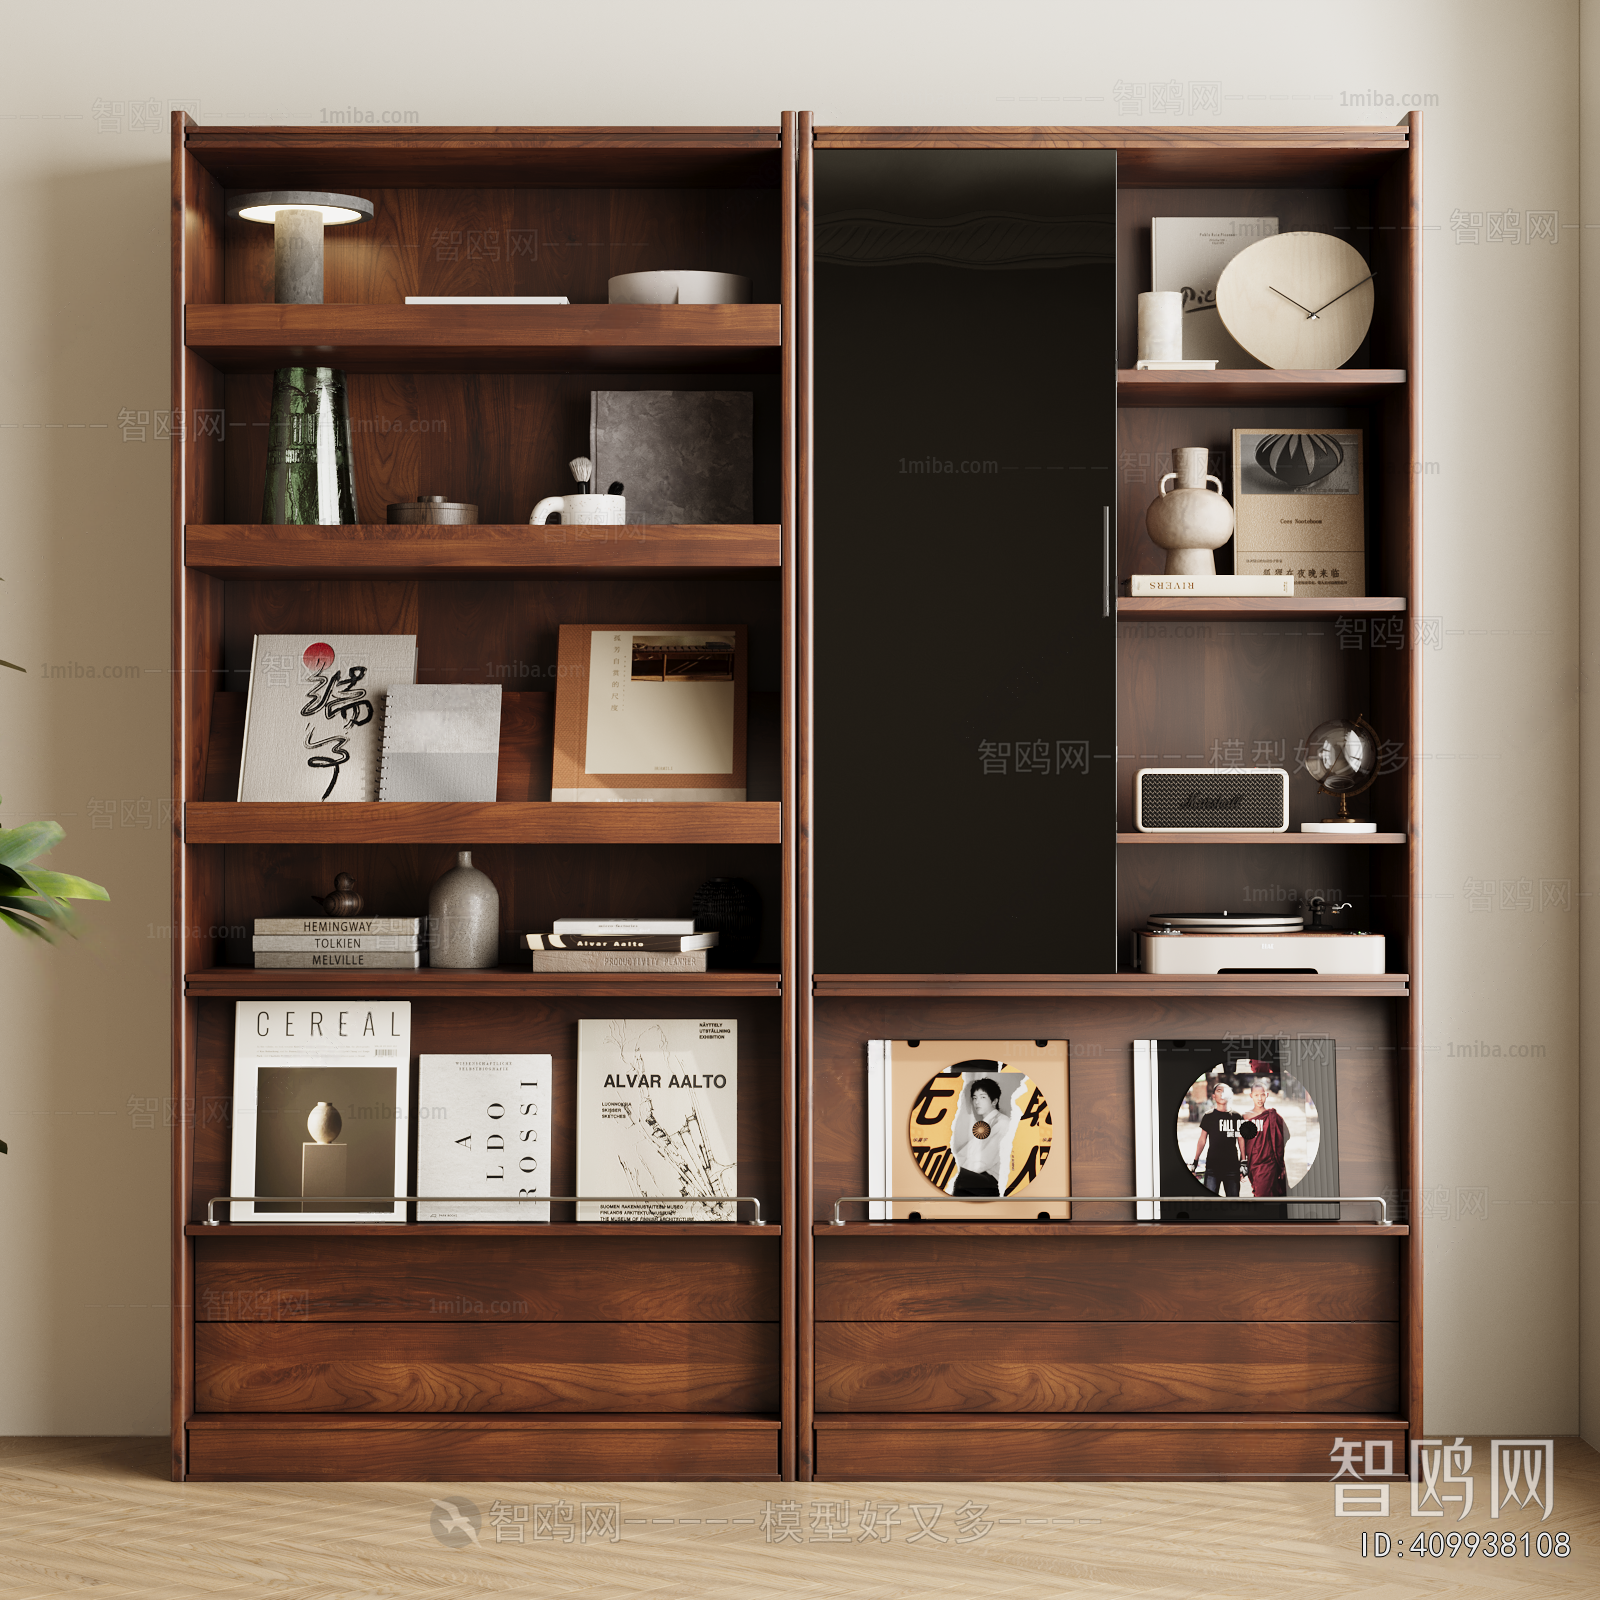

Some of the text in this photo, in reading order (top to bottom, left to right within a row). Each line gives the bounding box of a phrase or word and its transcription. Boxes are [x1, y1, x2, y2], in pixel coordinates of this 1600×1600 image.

[1149, 581, 1195, 590] RIVERS
[303, 921, 373, 932] HEMINGWAY
[314, 938, 361, 949] TOLKIEN
[312, 954, 364, 965] MELVILLE
[603, 957, 697, 967] PRODUCTIVITY PLANNER
[256, 1011, 401, 1037] CEREAL
[603, 1074, 727, 1089] ALVAR AALTO
[1219, 1119, 1235, 1132] FALL
